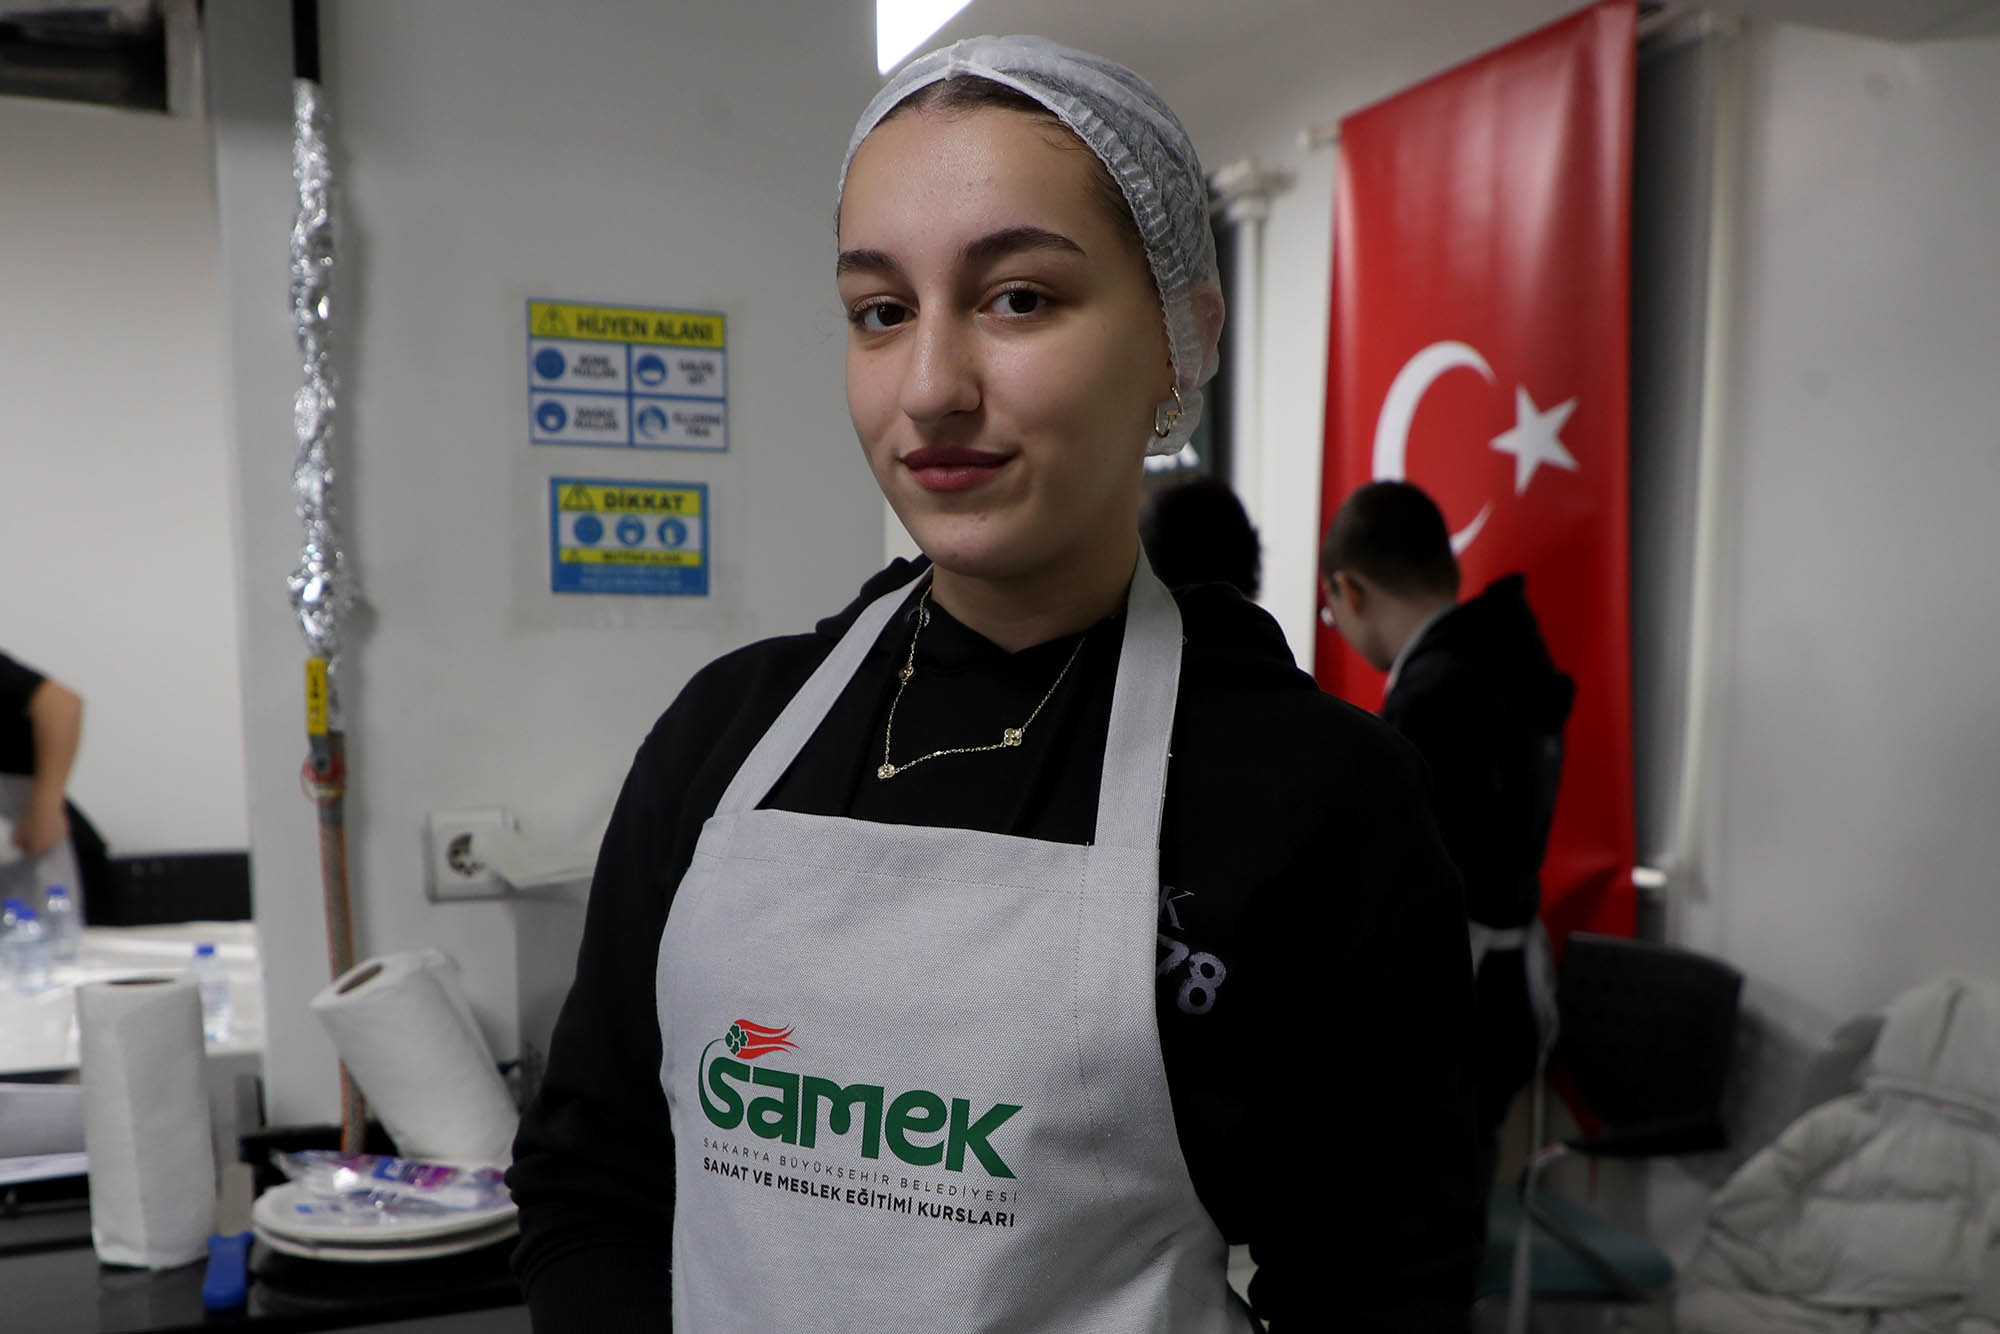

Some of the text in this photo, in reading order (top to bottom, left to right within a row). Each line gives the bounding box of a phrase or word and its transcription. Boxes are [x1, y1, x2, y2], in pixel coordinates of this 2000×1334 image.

[603, 487, 685, 511] DİKKAT
[703, 1137, 1018, 1203] SAKARYA BÜYÜKŞEHİR BELEDİYESİ
[703, 1156, 1016, 1228] SANAT VE MESLEK EĞİTİMİ KURSLARI
